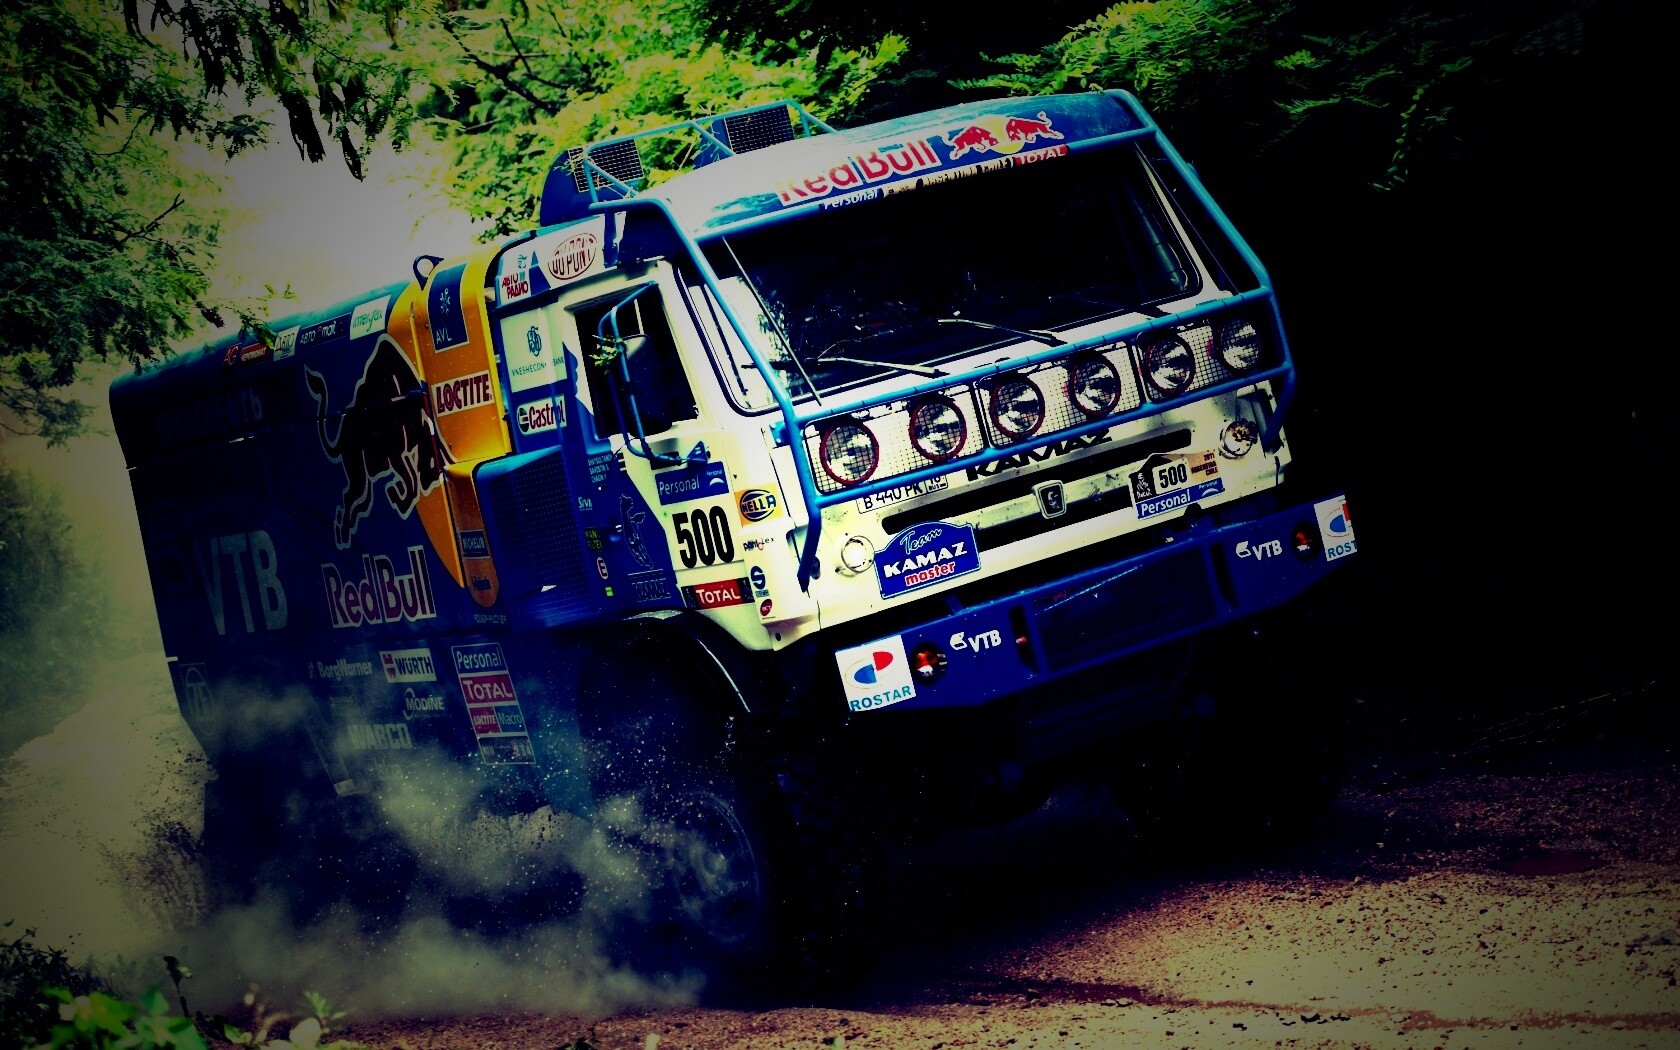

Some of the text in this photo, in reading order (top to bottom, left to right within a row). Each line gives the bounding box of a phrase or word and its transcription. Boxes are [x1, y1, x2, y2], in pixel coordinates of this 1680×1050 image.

[1015, 147, 1066, 164] TOTAL
[778, 157, 862, 203] Red
[856, 138, 938, 181] Bull
[823, 189, 878, 209] Personal
[435, 327, 452, 344] AVL
[436, 374, 491, 414] LOCTITE
[659, 474, 700, 495] Personal
[1158, 463, 1188, 489] 500
[741, 494, 777, 513] HELLA
[1141, 488, 1191, 516] Personal
[672, 505, 735, 569] 500
[901, 525, 943, 555] Team
[1252, 539, 1283, 561] VTB
[883, 541, 968, 579] KAMAZ
[905, 560, 956, 586] master
[195, 529, 288, 636] VTB
[321, 545, 437, 628] Red Bull
[695, 588, 741, 605] TOTAL
[968, 629, 1002, 652] VTB
[316, 658, 373, 681] BorgWarner
[456, 647, 502, 673] Personal
[462, 680, 513, 701] TOTAL
[850, 685, 912, 712] ROSTAR
[497, 712, 523, 725] Macro
[347, 723, 413, 750] WABCO
